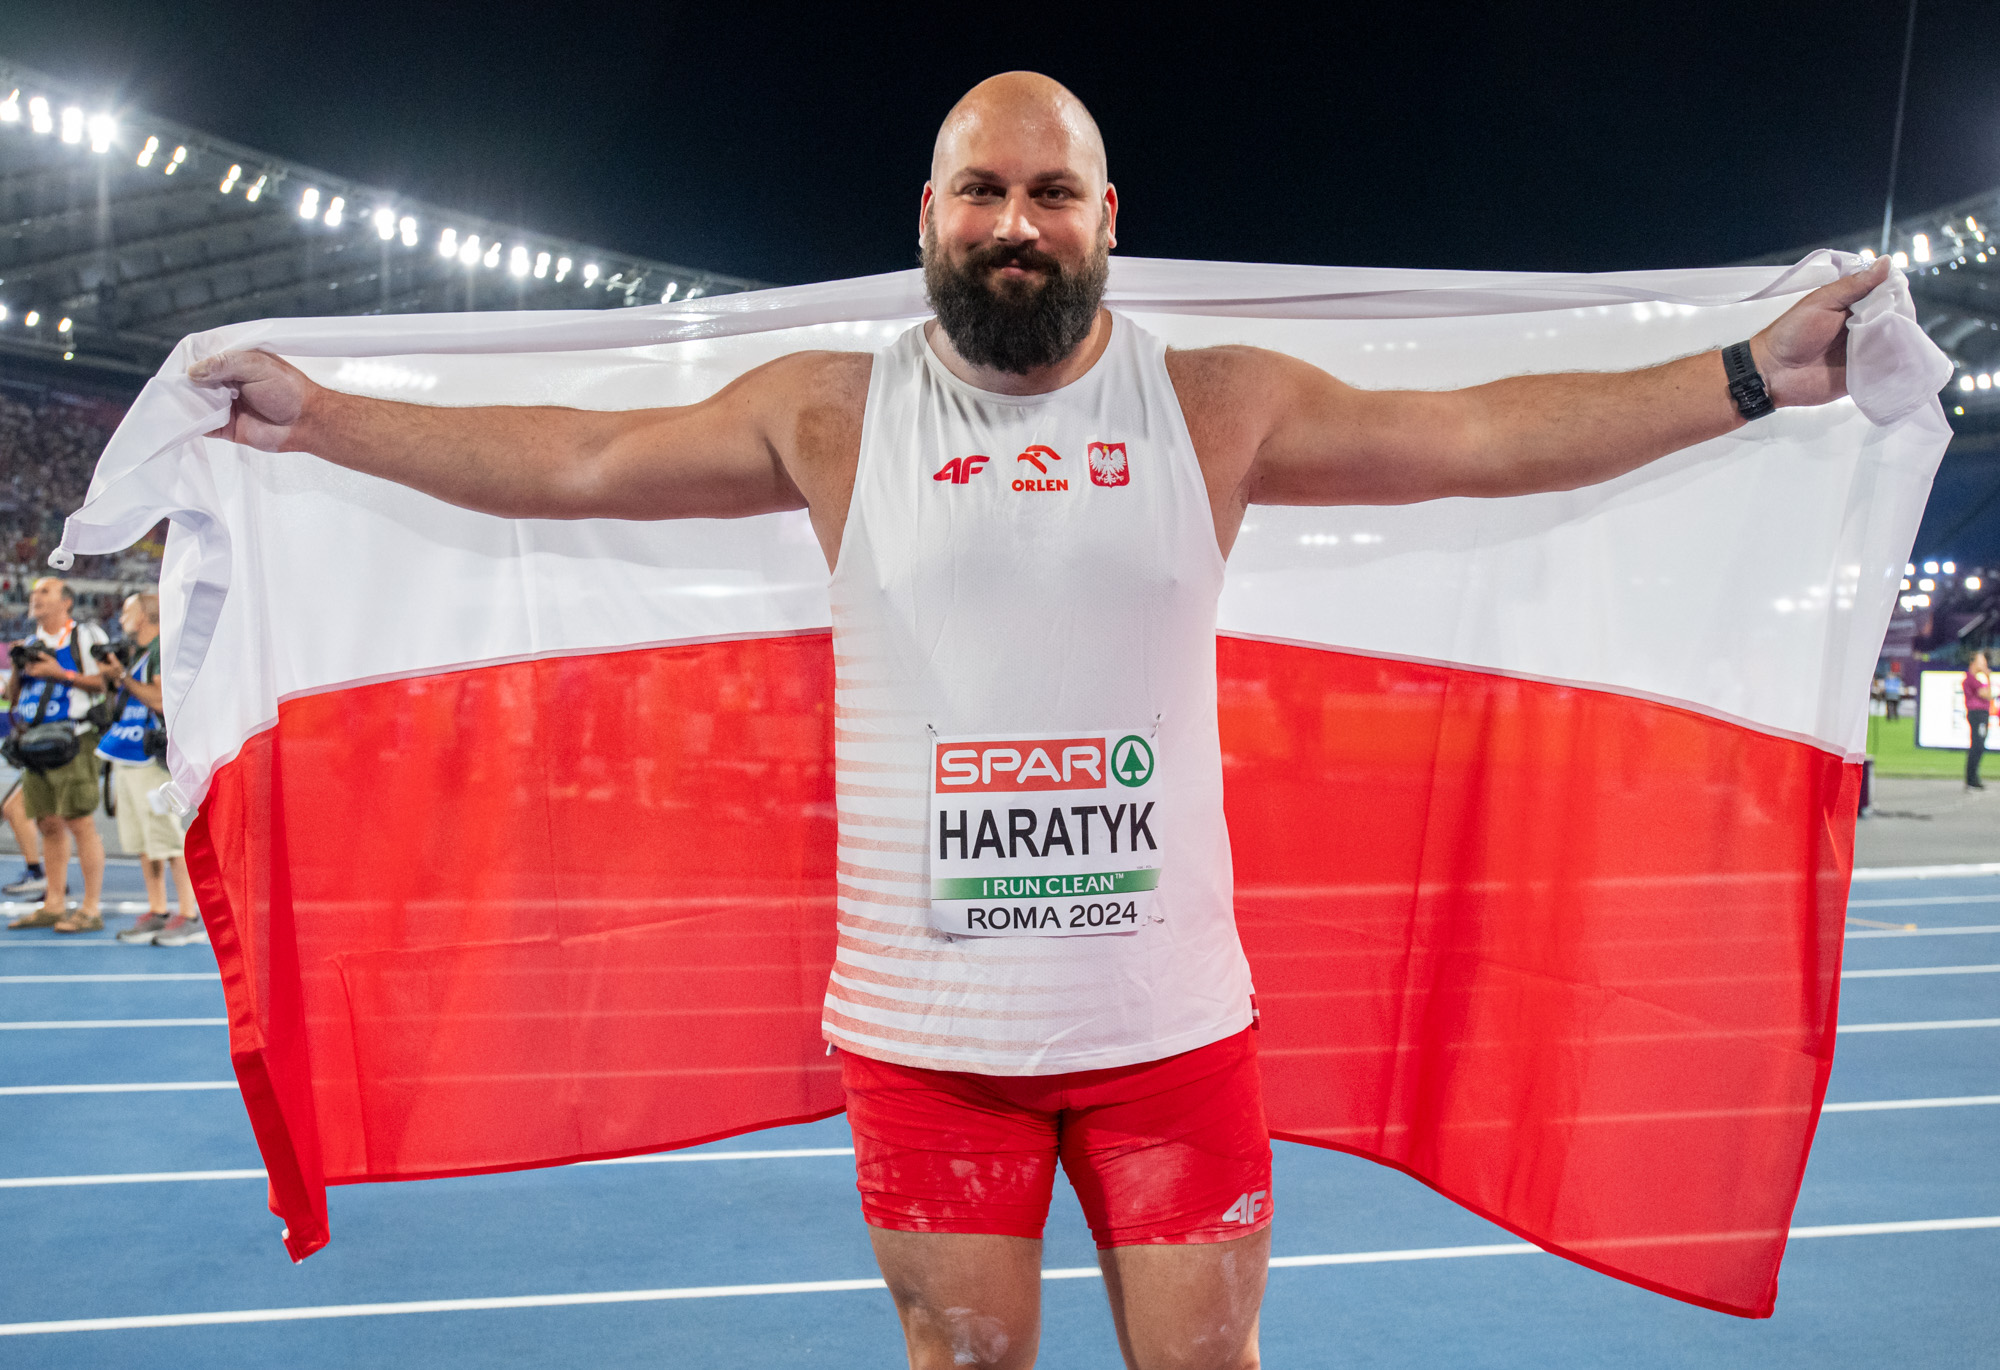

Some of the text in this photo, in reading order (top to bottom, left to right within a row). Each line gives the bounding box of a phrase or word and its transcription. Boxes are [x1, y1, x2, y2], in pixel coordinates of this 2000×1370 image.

[1012, 479, 1069, 492] ORLEN
[941, 746, 1101, 785] SPAR
[939, 801, 1158, 860] HARATYK
[983, 880, 988, 896] I
[994, 879, 1040, 896] RUN
[967, 901, 1138, 930] ROMA 2024
